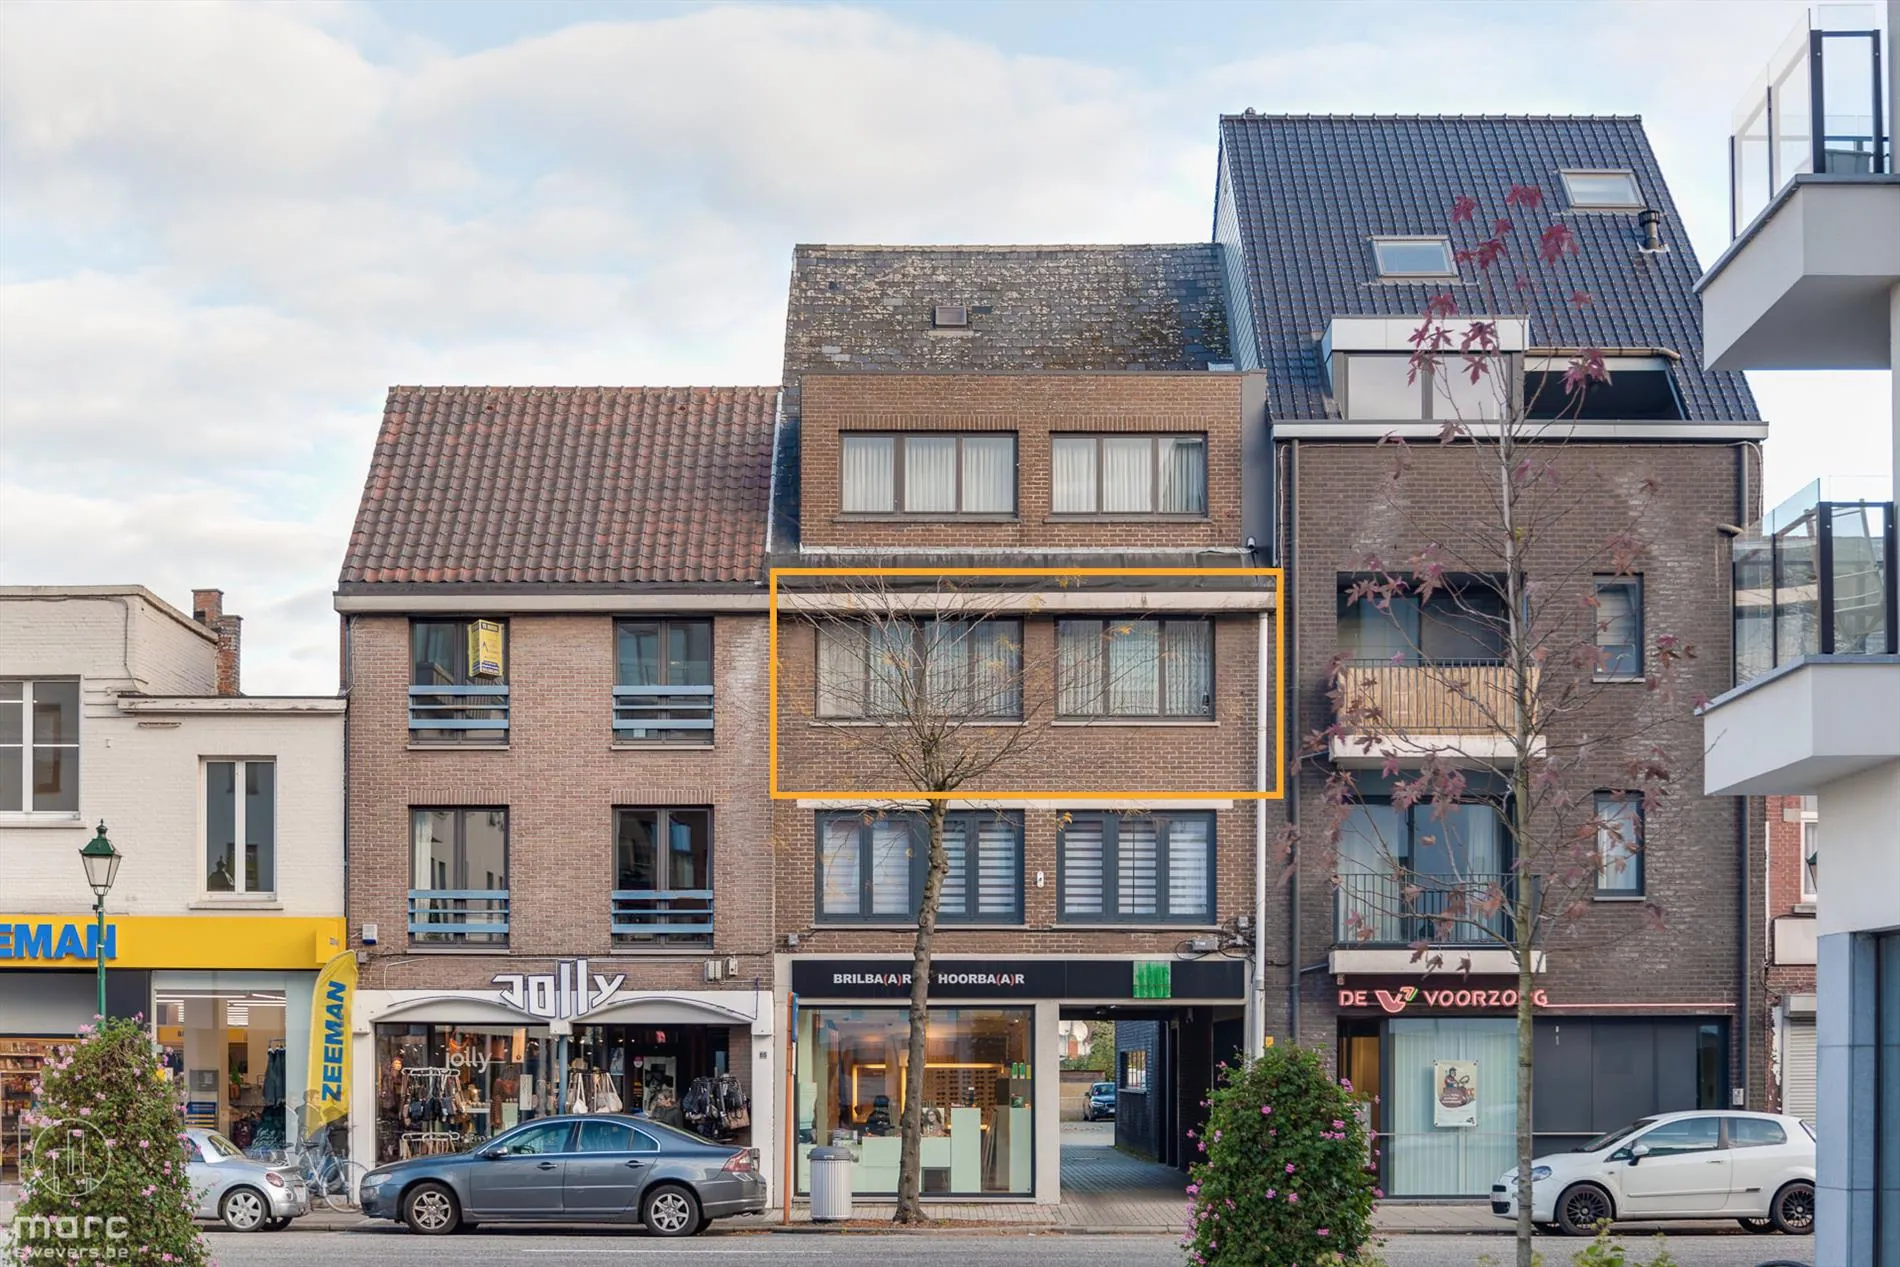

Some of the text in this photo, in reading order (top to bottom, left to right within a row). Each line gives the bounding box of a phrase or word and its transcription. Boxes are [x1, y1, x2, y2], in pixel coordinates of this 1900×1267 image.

[833, 973, 912, 987] BRILBA(A)R
[938, 973, 1025, 987] HOORBA(A)R
[1338, 989, 1368, 1006] DE
[1423, 989, 1548, 1007] VOORZOG
[321, 980, 347, 1102] ZEEMAN
[445, 1046, 492, 1073] jolly
